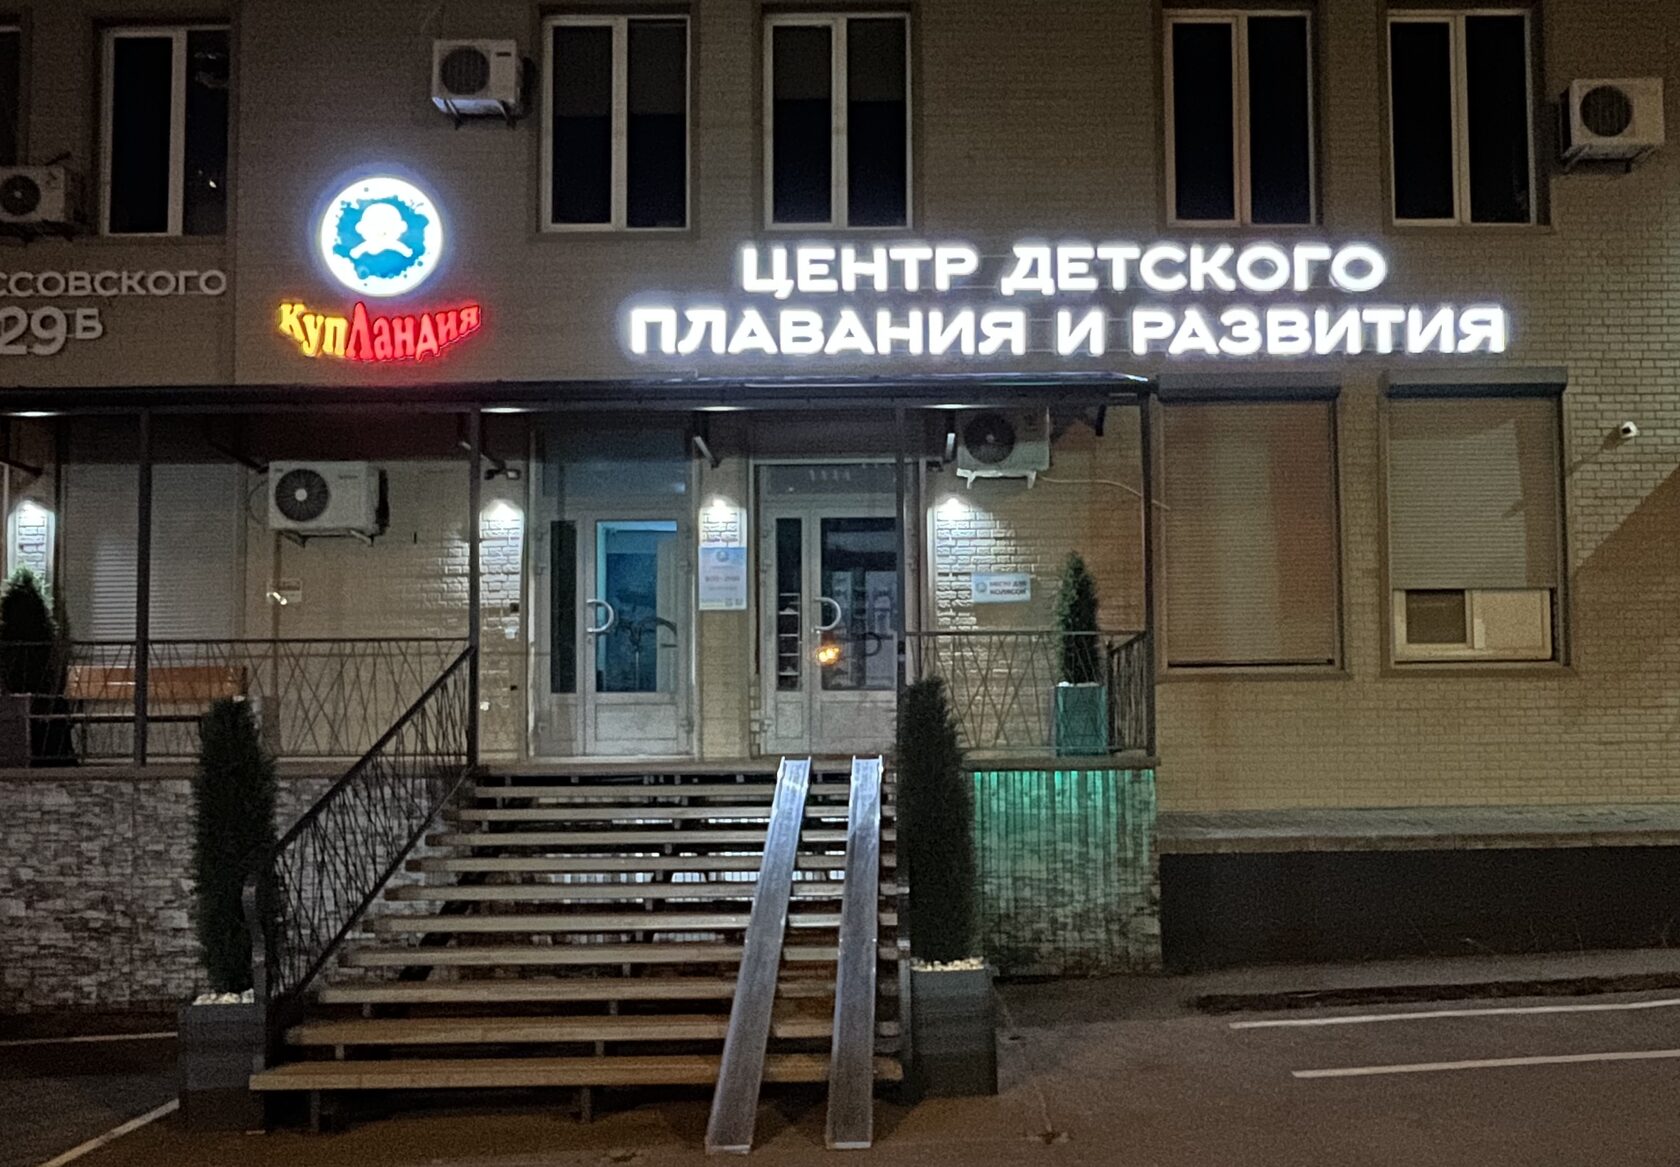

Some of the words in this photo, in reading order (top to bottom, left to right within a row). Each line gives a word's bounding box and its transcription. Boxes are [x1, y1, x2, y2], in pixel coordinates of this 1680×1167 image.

[0, 269, 227, 297] СОВСКОГО
[741, 245, 979, 299] ЦЕНТР
[1001, 245, 1388, 296] ДЕТСКОГО
[630, 307, 1027, 356] ПЛАВАНИЯ
[1056, 307, 1105, 356] И
[1131, 307, 1507, 356] РАЗВИТИЯ
